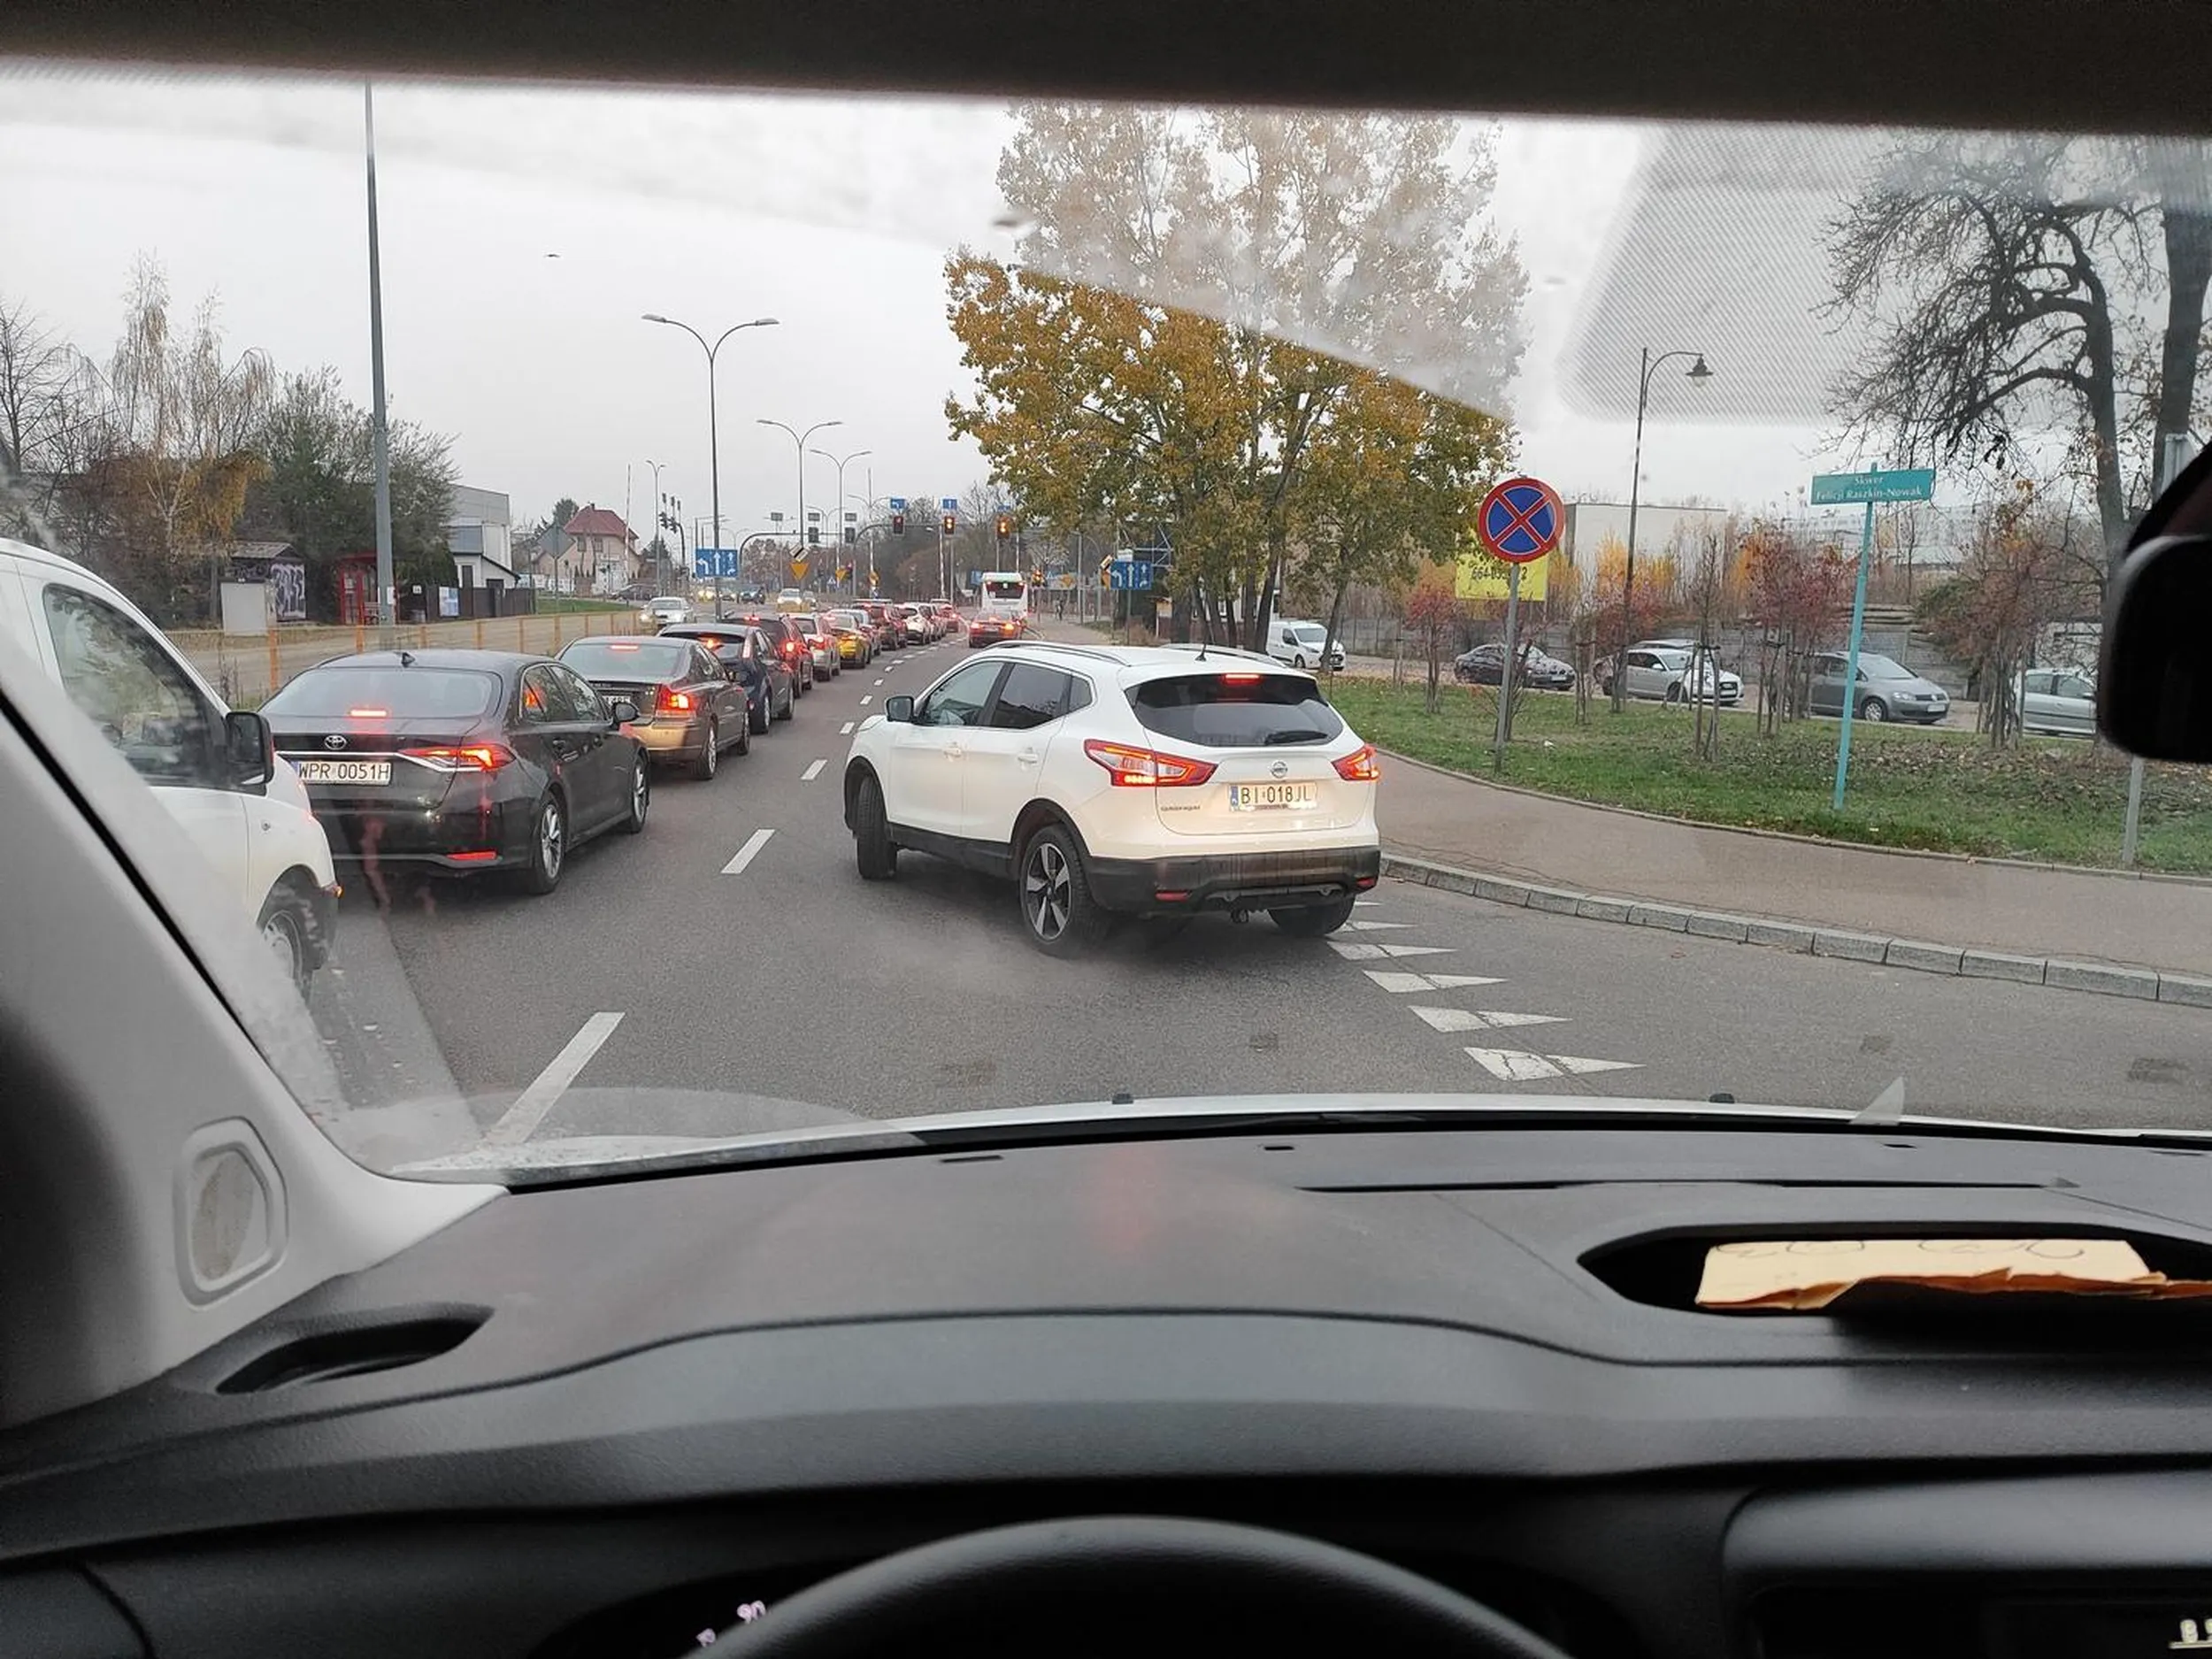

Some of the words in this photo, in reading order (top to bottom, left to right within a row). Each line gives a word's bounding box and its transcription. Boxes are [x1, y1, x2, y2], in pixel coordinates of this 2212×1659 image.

[1855, 476, 1884, 486] Skwer
[299, 763, 332, 779] WPR
[337, 763, 389, 780] 0051H
[1240, 787, 1259, 804] BI
[1266, 786, 1311, 803] 018JL
